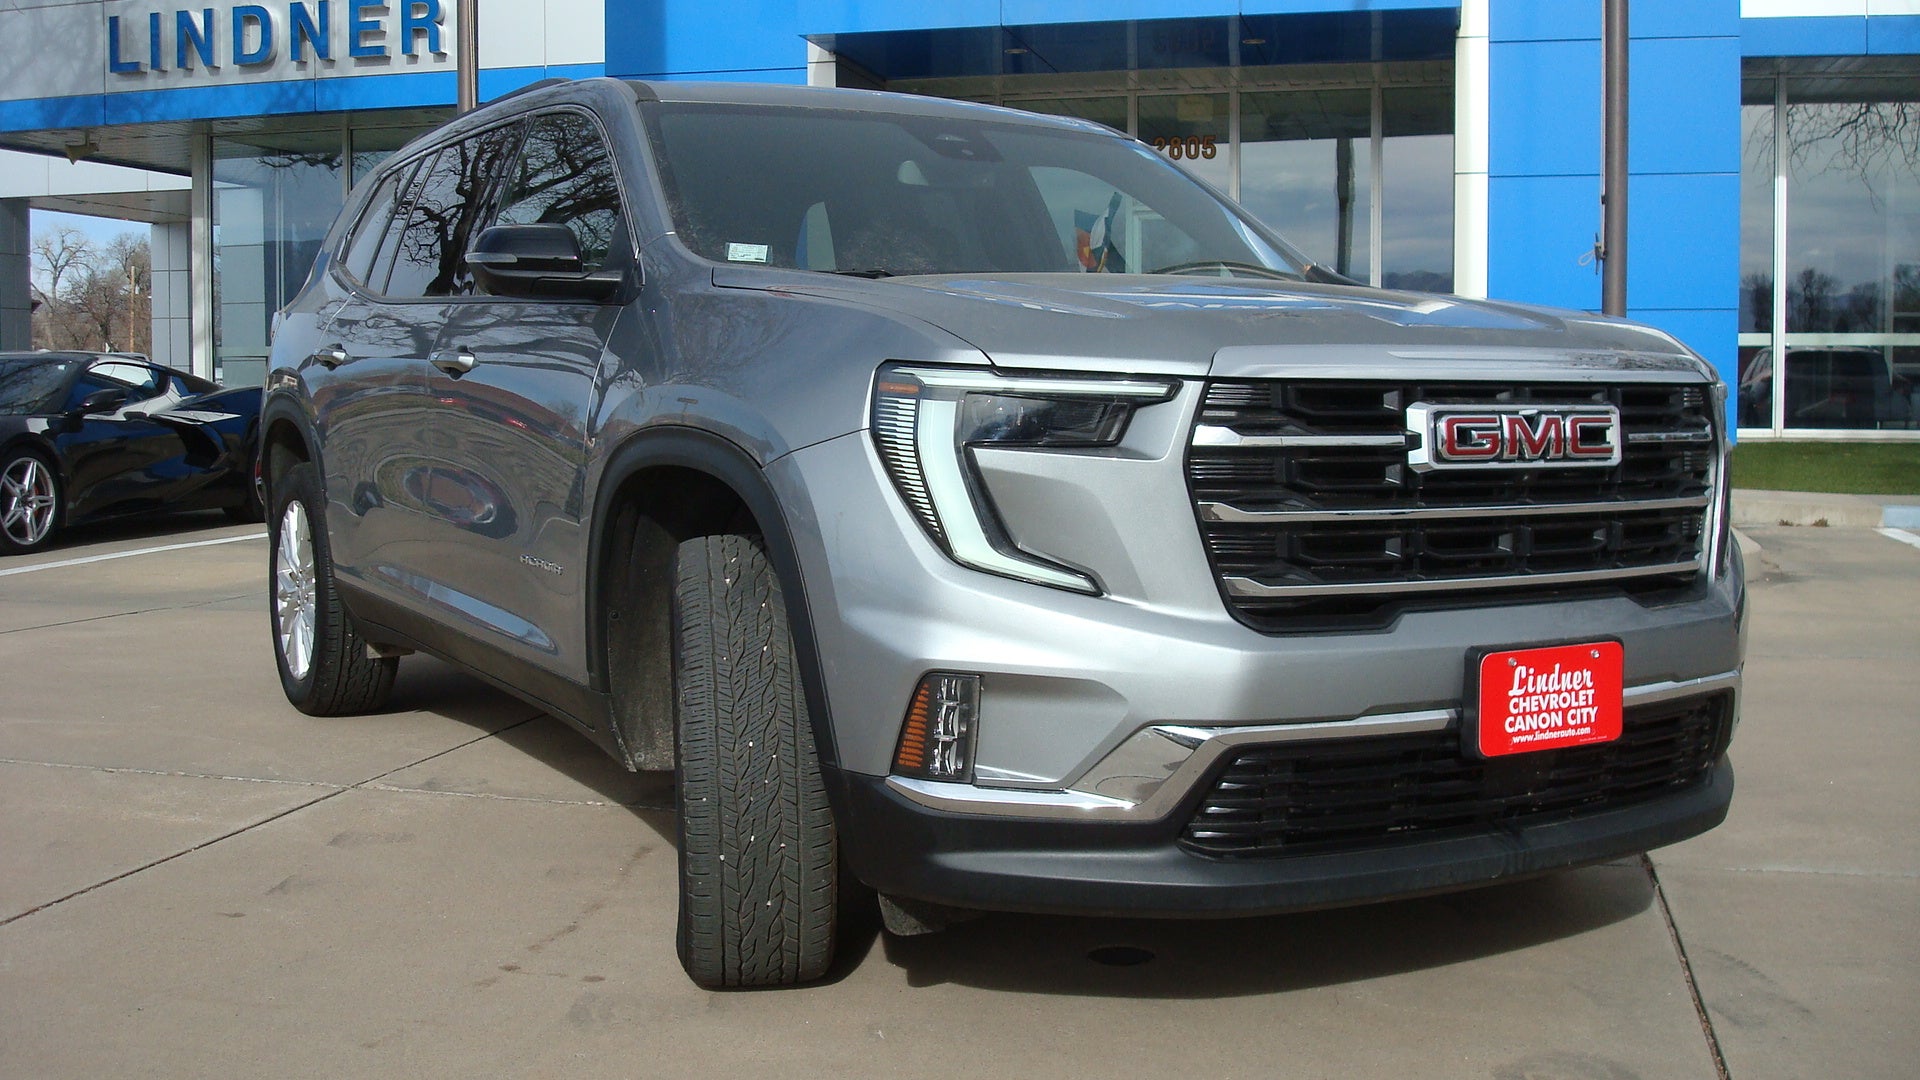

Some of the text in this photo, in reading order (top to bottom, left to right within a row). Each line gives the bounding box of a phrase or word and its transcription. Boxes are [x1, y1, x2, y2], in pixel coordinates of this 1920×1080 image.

[109, 0, 447, 74] LINDNER
[1153, 135, 1217, 160] 2805
[1437, 413, 1614, 460] GMC
[1508, 663, 1593, 696] Lindner
[1509, 689, 1595, 714] CHEVROLET
[1504, 706, 1598, 733] CANON CITY
[1512, 727, 1591, 744] www.lindnerauto.com
